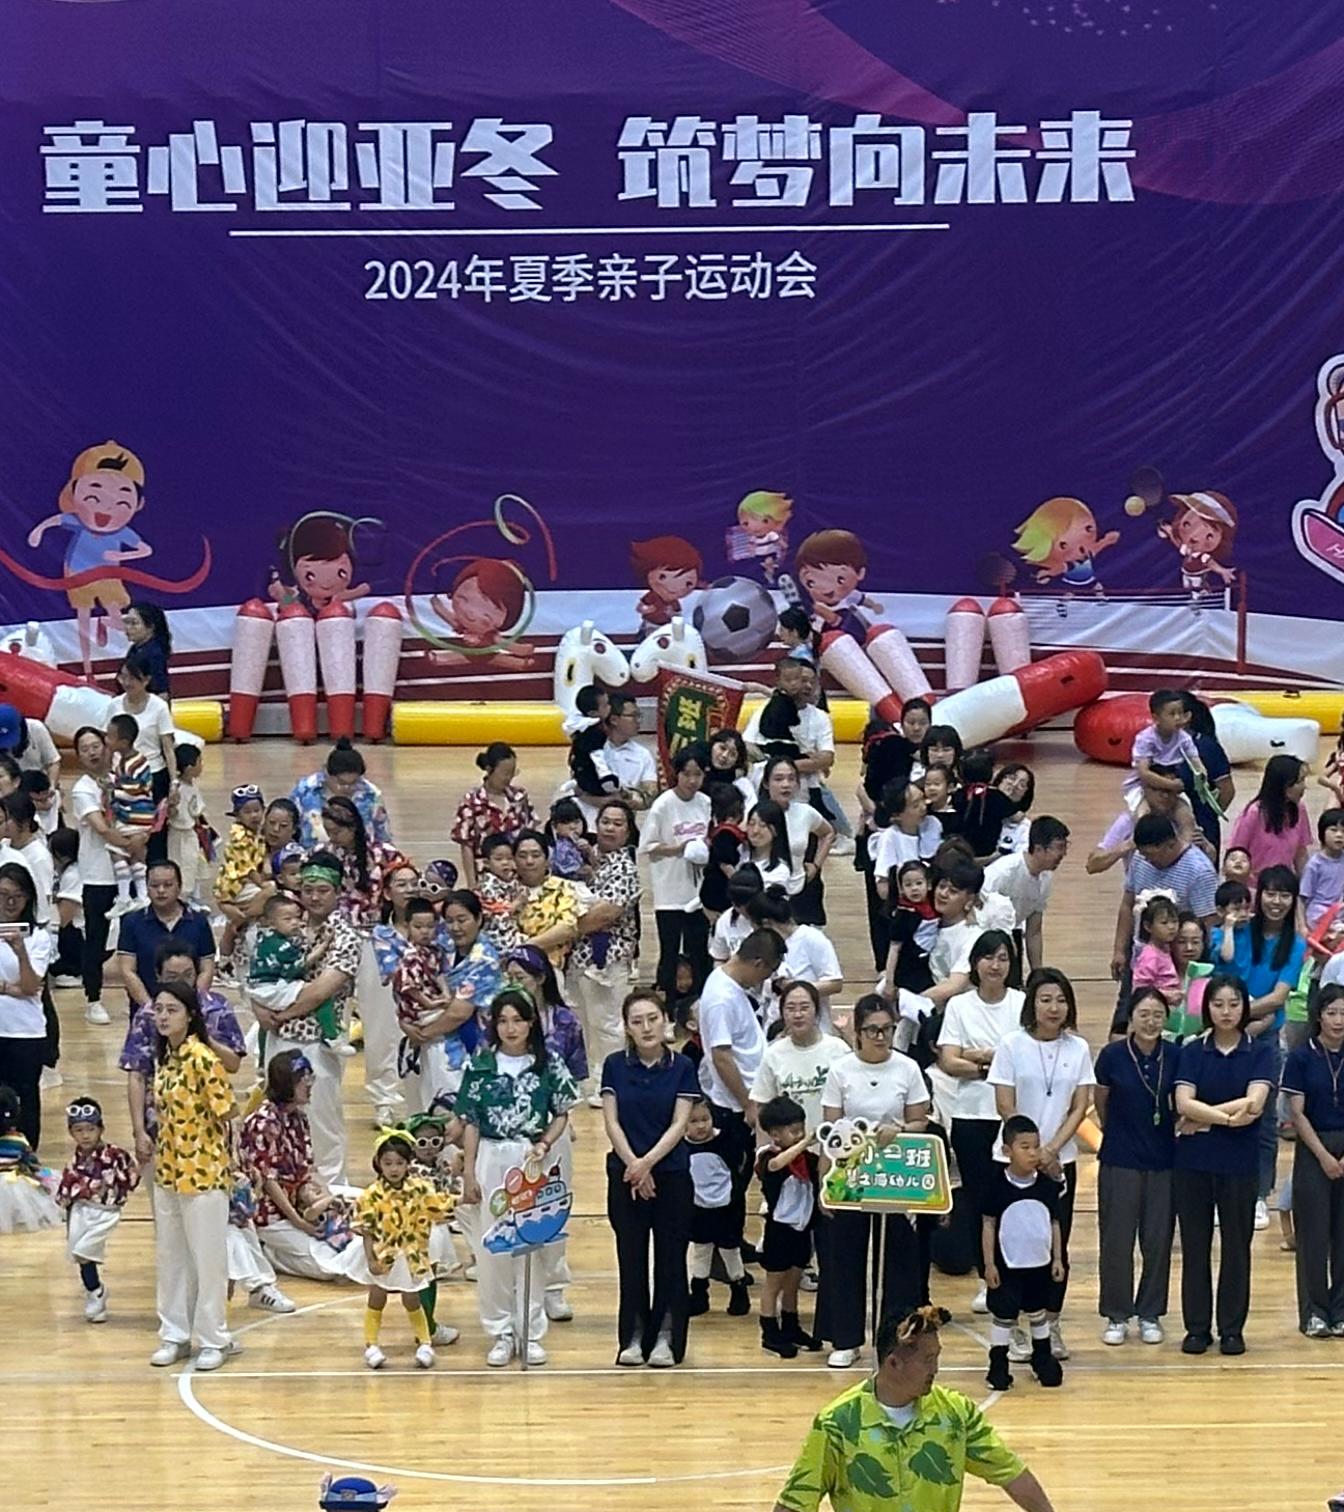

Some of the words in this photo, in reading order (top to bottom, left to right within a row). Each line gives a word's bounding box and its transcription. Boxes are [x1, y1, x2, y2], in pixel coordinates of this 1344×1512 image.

[40, 118, 559, 213] 童心迎亚冬
[617, 110, 1137, 208] 筑梦向未来
[363, 250, 817, 303] 2024年夏季亲子运动会
[860, 1145, 931, 1168] 小二班
